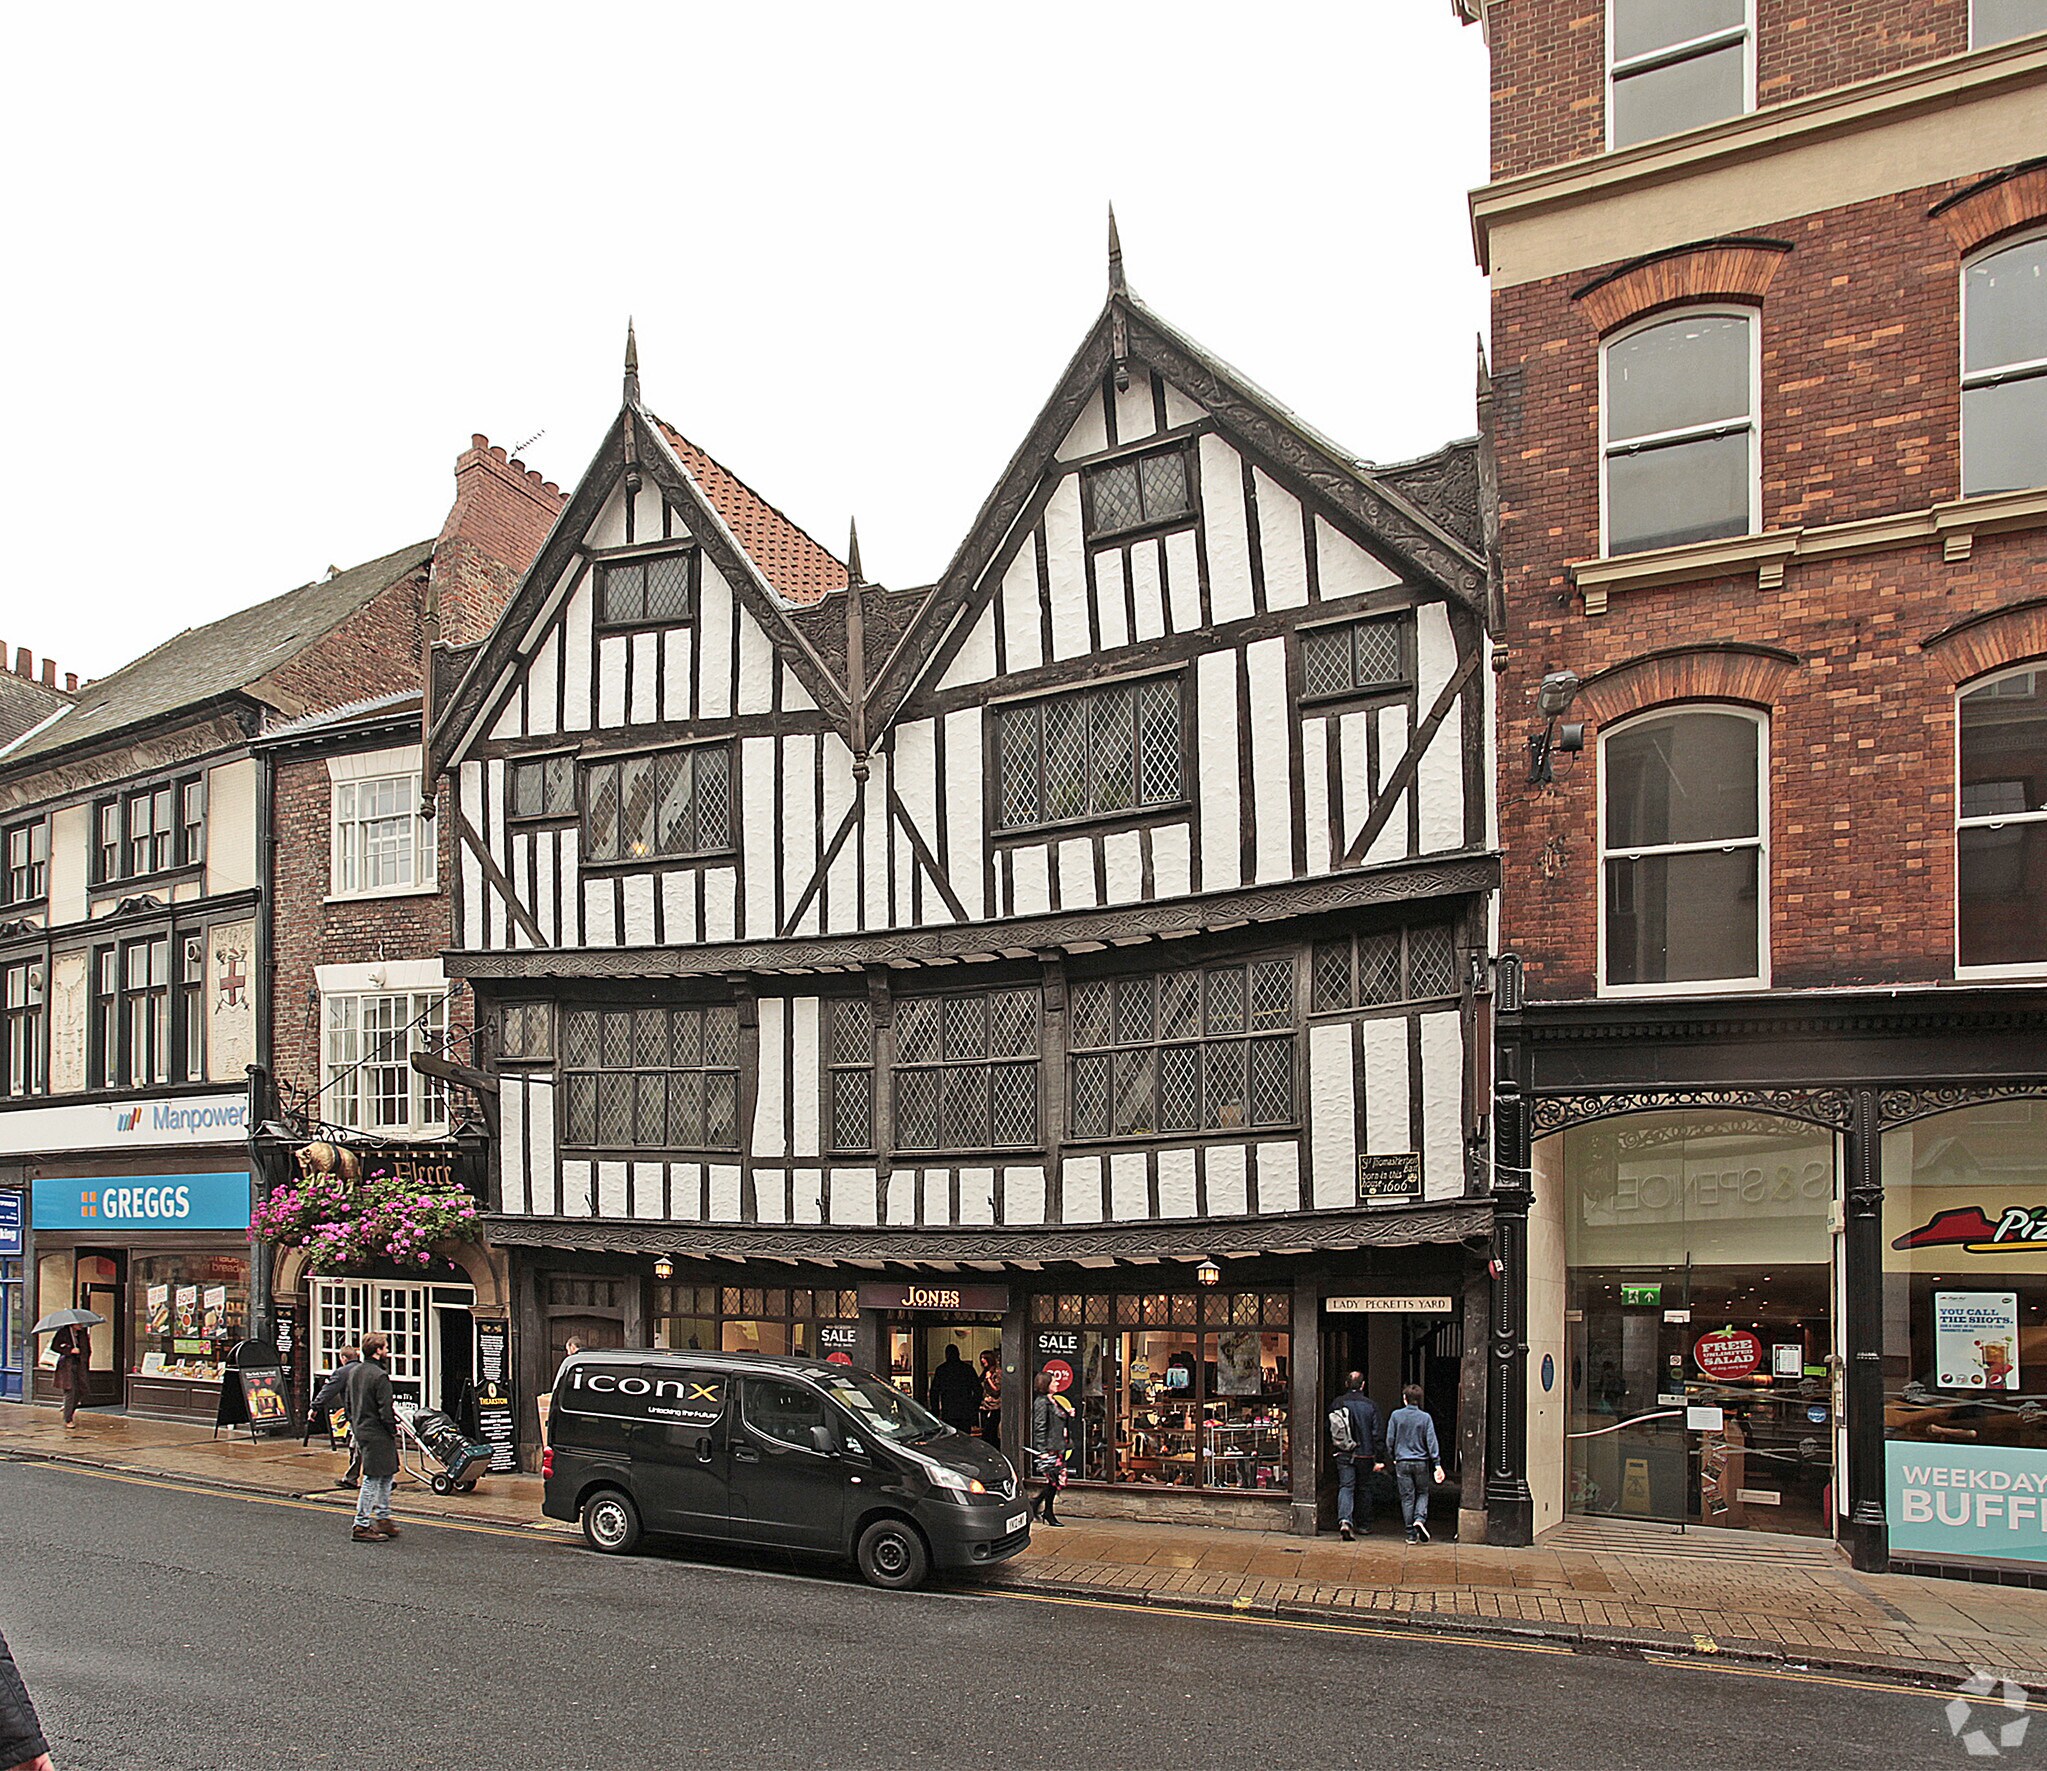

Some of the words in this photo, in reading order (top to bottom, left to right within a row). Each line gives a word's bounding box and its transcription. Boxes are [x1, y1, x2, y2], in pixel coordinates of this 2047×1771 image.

[153, 1104, 247, 1134] Manpower
[392, 1161, 453, 1185] Fleece
[1380, 1171, 1387, 1179] in
[1388, 1170, 1402, 1179] this
[1383, 1179, 1409, 1192] 1606
[102, 1185, 190, 1218] GREGGS
[212, 1263, 240, 1273] bread
[1333, 1299, 1360, 1309] LADY
[1365, 1299, 1414, 1309] PECKETTS
[1418, 1299, 1446, 1309] YARD
[1966, 1308, 1999, 1316] CALL
[1968, 1316, 2014, 1324] SHOTS.
[821, 1329, 856, 1343] SALE
[1038, 1335, 1078, 1349] SALE
[1701, 1339, 1753, 1353] FREE
[1703, 1349, 1754, 1358] UNLIMITED
[1704, 1354, 1754, 1366] SALAD
[1046, 1369, 1069, 1381] 0%
[573, 1367, 720, 1402] iconx
[648, 1406, 681, 1417] Unlocking
[1902, 1465, 2047, 1493] WEEKDAY
[1902, 1488, 2047, 1532] BUFF
